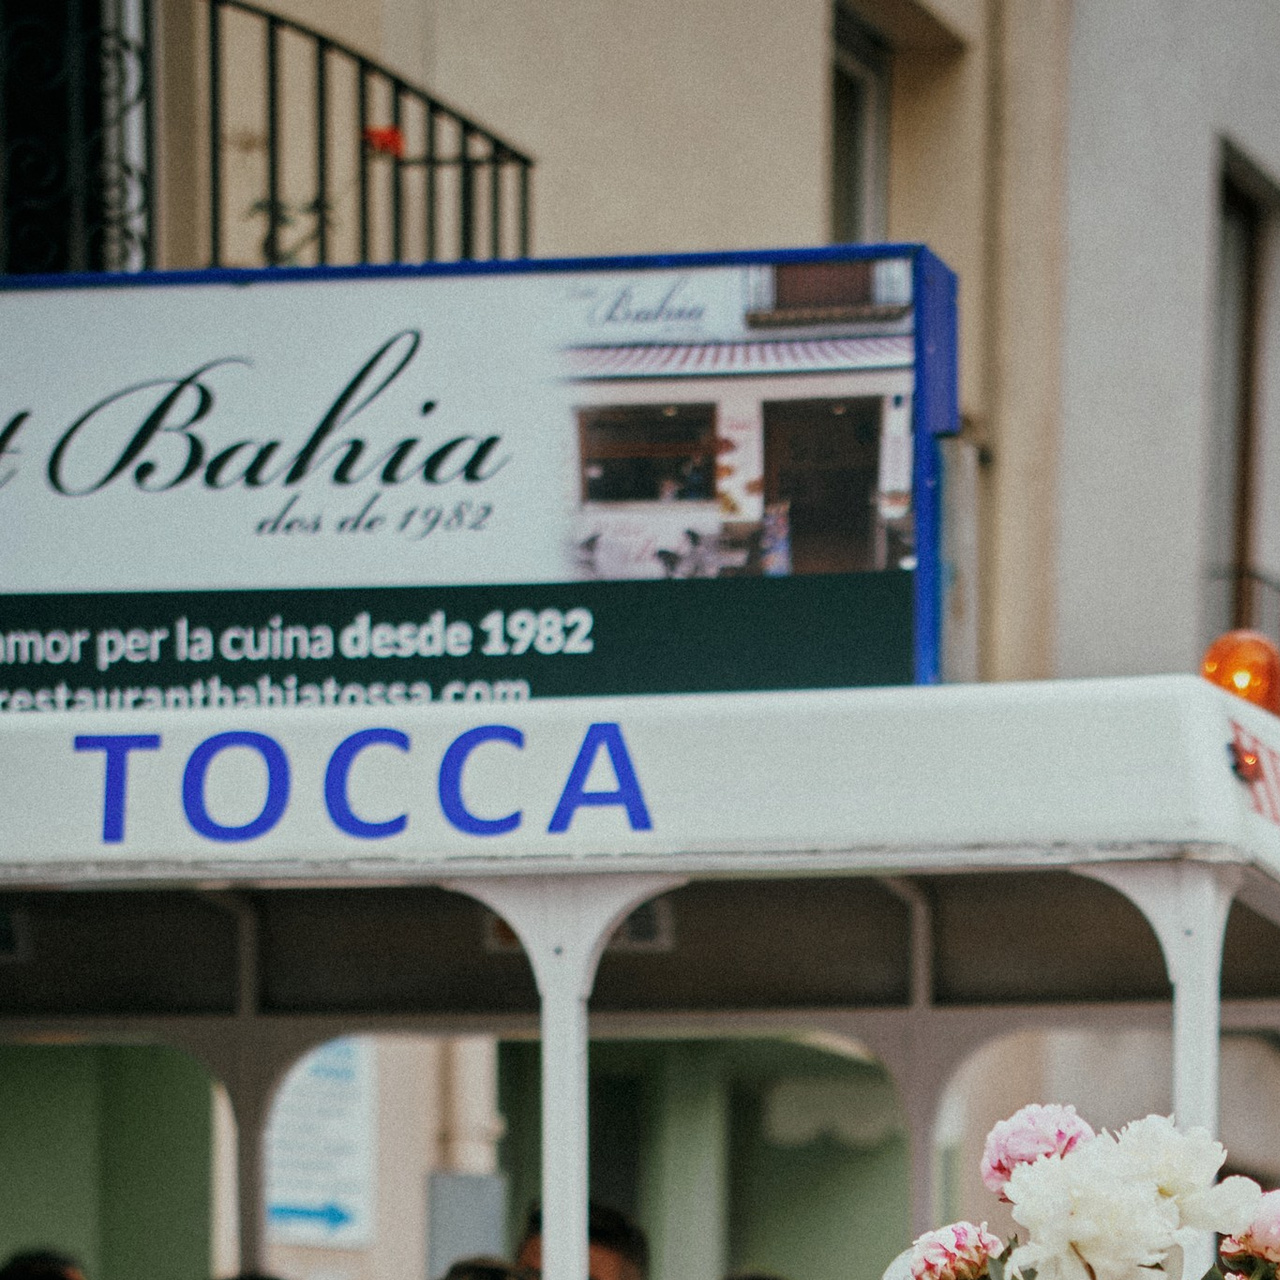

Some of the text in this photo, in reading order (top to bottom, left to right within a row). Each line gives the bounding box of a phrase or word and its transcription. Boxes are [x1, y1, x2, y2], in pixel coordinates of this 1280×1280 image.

[46, 328, 512, 497] Bahia
[396, 500, 495, 542] 1982
[0, 606, 595, 672] mor per la cuina desde 1982
[74, 722, 653, 845] TOCCA
